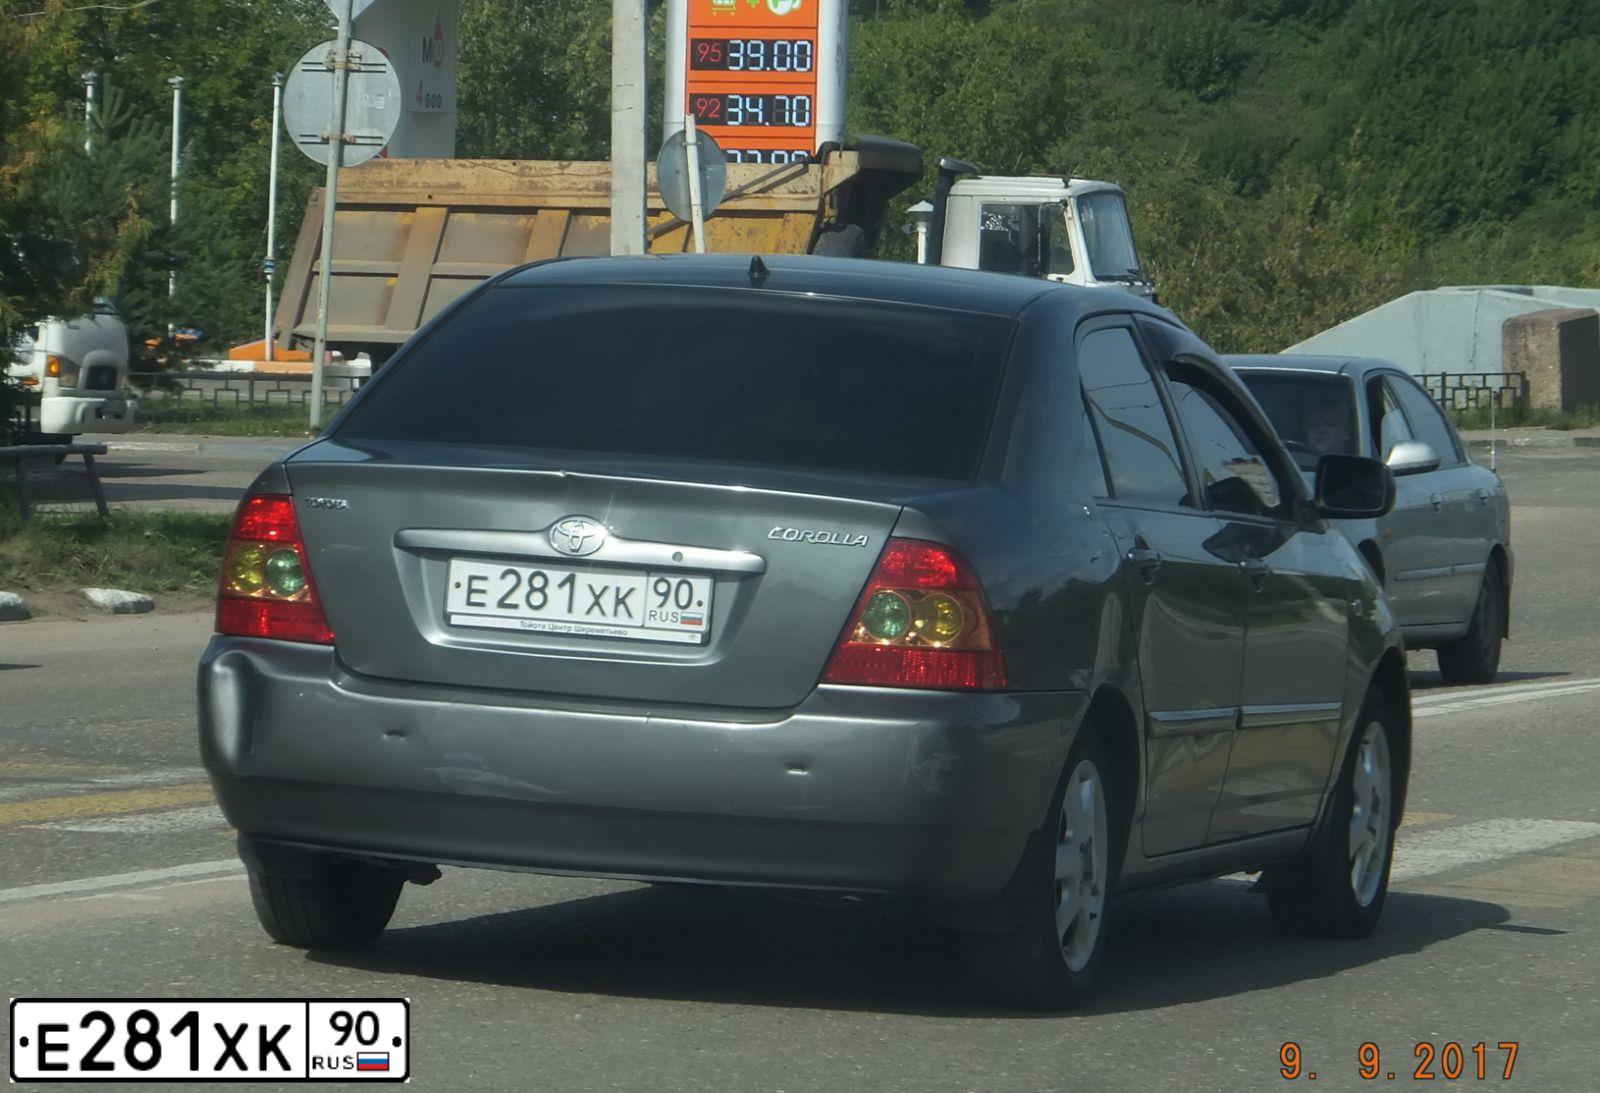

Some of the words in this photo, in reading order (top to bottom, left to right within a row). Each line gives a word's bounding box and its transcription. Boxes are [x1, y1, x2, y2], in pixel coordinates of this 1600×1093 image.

[698, 42, 722, 62] 95
[728, 40, 811, 71] 39.00
[696, 98, 721, 118] 92
[727, 95, 810, 126] 34.70
[767, 526, 870, 547] COROLLA
[652, 576, 694, 610] 90
[648, 610, 679, 623] RUS
